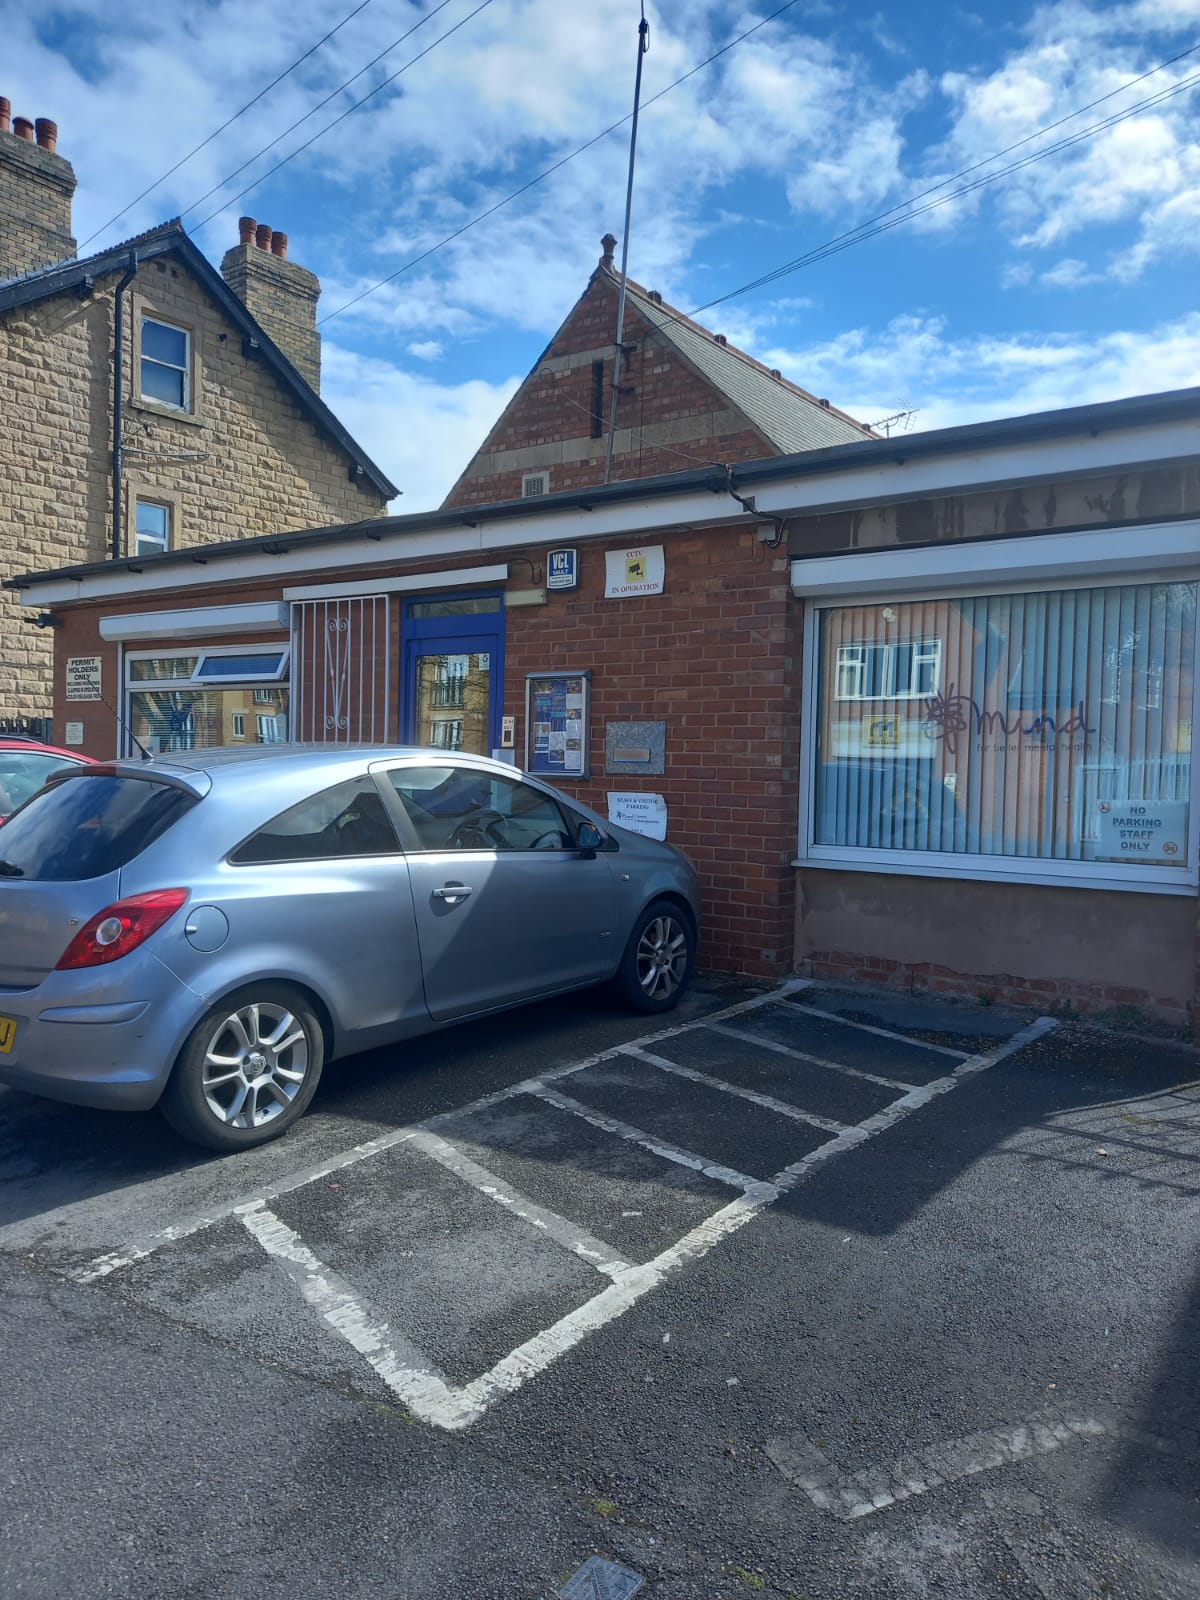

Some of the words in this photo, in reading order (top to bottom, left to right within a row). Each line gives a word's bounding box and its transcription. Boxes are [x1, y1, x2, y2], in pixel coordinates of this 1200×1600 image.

[552, 553, 569, 569] VCL
[620, 583, 660, 592] OPERATION
[68, 666, 99, 674] HOLDERS
[969, 698, 1097, 736] mind
[993, 743, 1021, 753] bete
[1024, 743, 1056, 752] meta
[1061, 743, 1093, 752] healh
[1129, 807, 1147, 815] NO
[1112, 818, 1162, 827] PARKING
[1119, 830, 1154, 838] STAFF
[1120, 841, 1150, 850] ONLY
